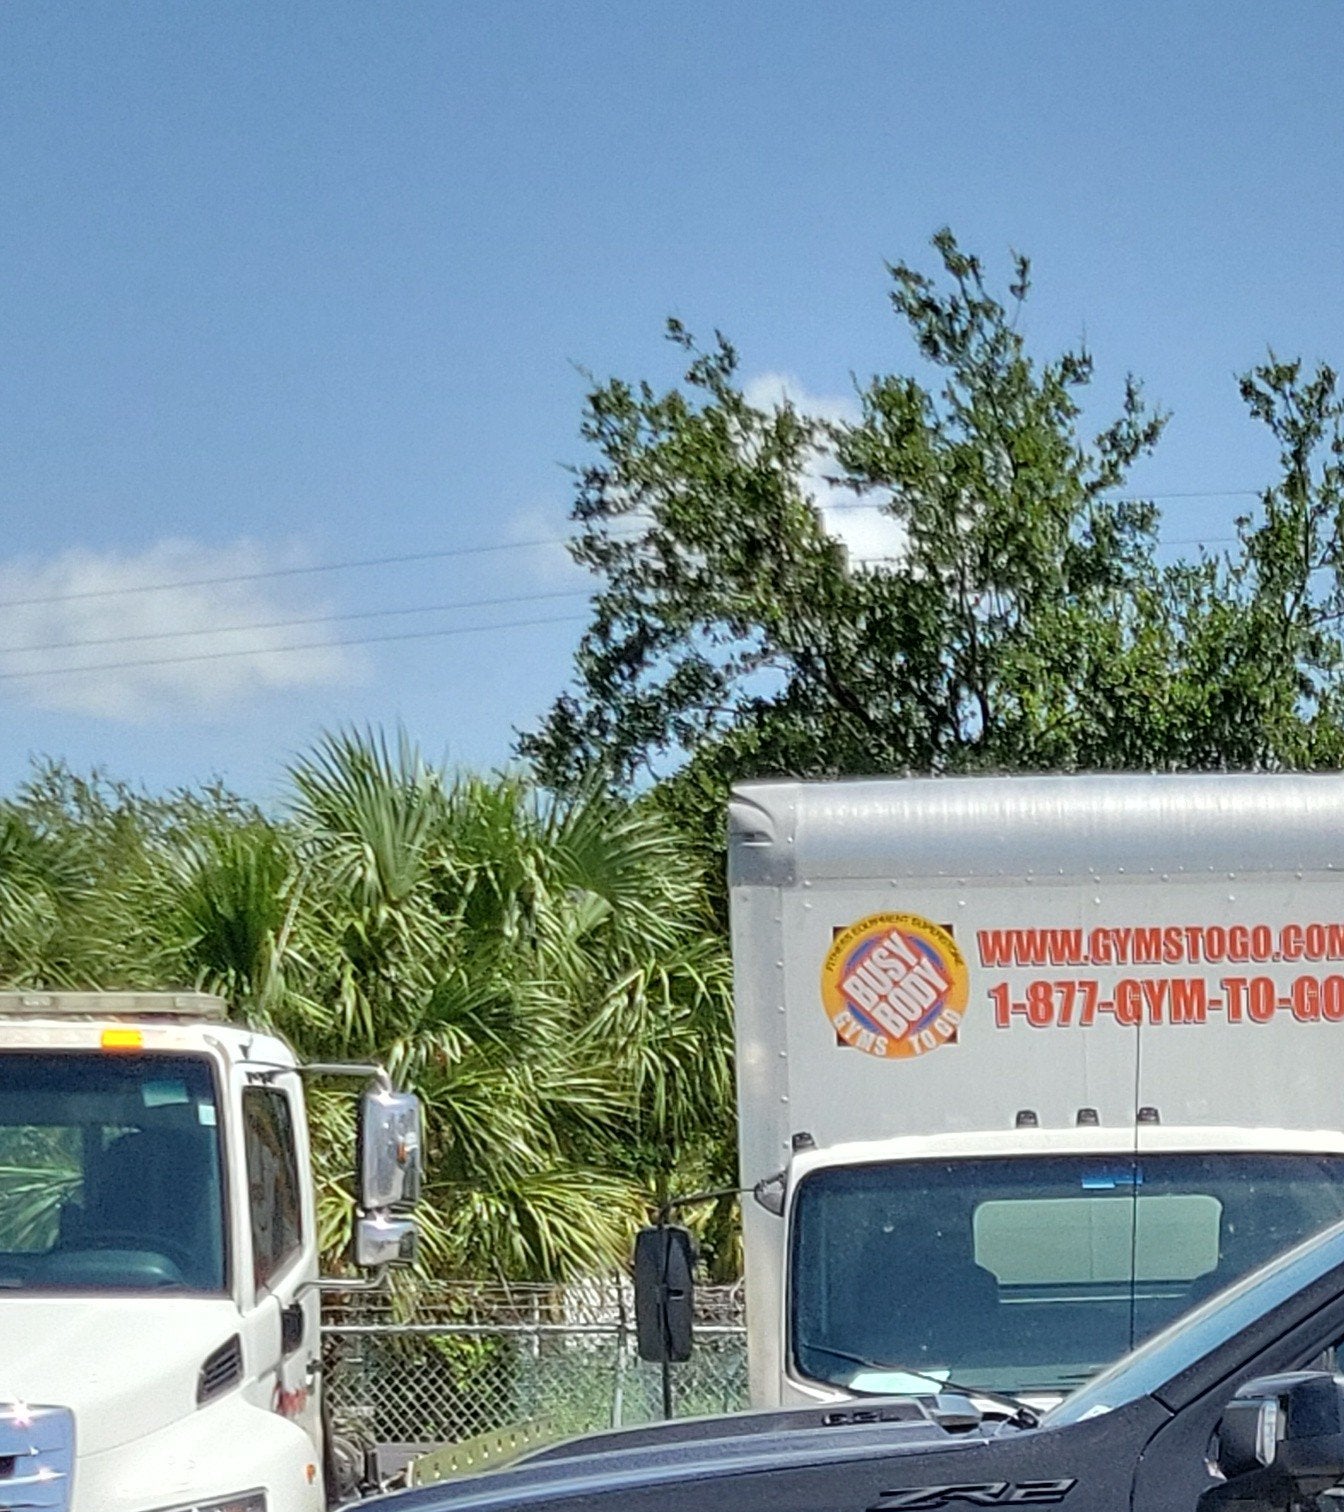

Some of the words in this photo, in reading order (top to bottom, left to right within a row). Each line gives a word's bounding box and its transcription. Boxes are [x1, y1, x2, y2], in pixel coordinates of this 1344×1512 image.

[842, 931, 918, 1012] BUSY
[870, 957, 949, 1039] BODY
[833, 1010, 889, 1056] GYMS
[908, 1031, 937, 1054] TO
[934, 1008, 962, 1037] GO
